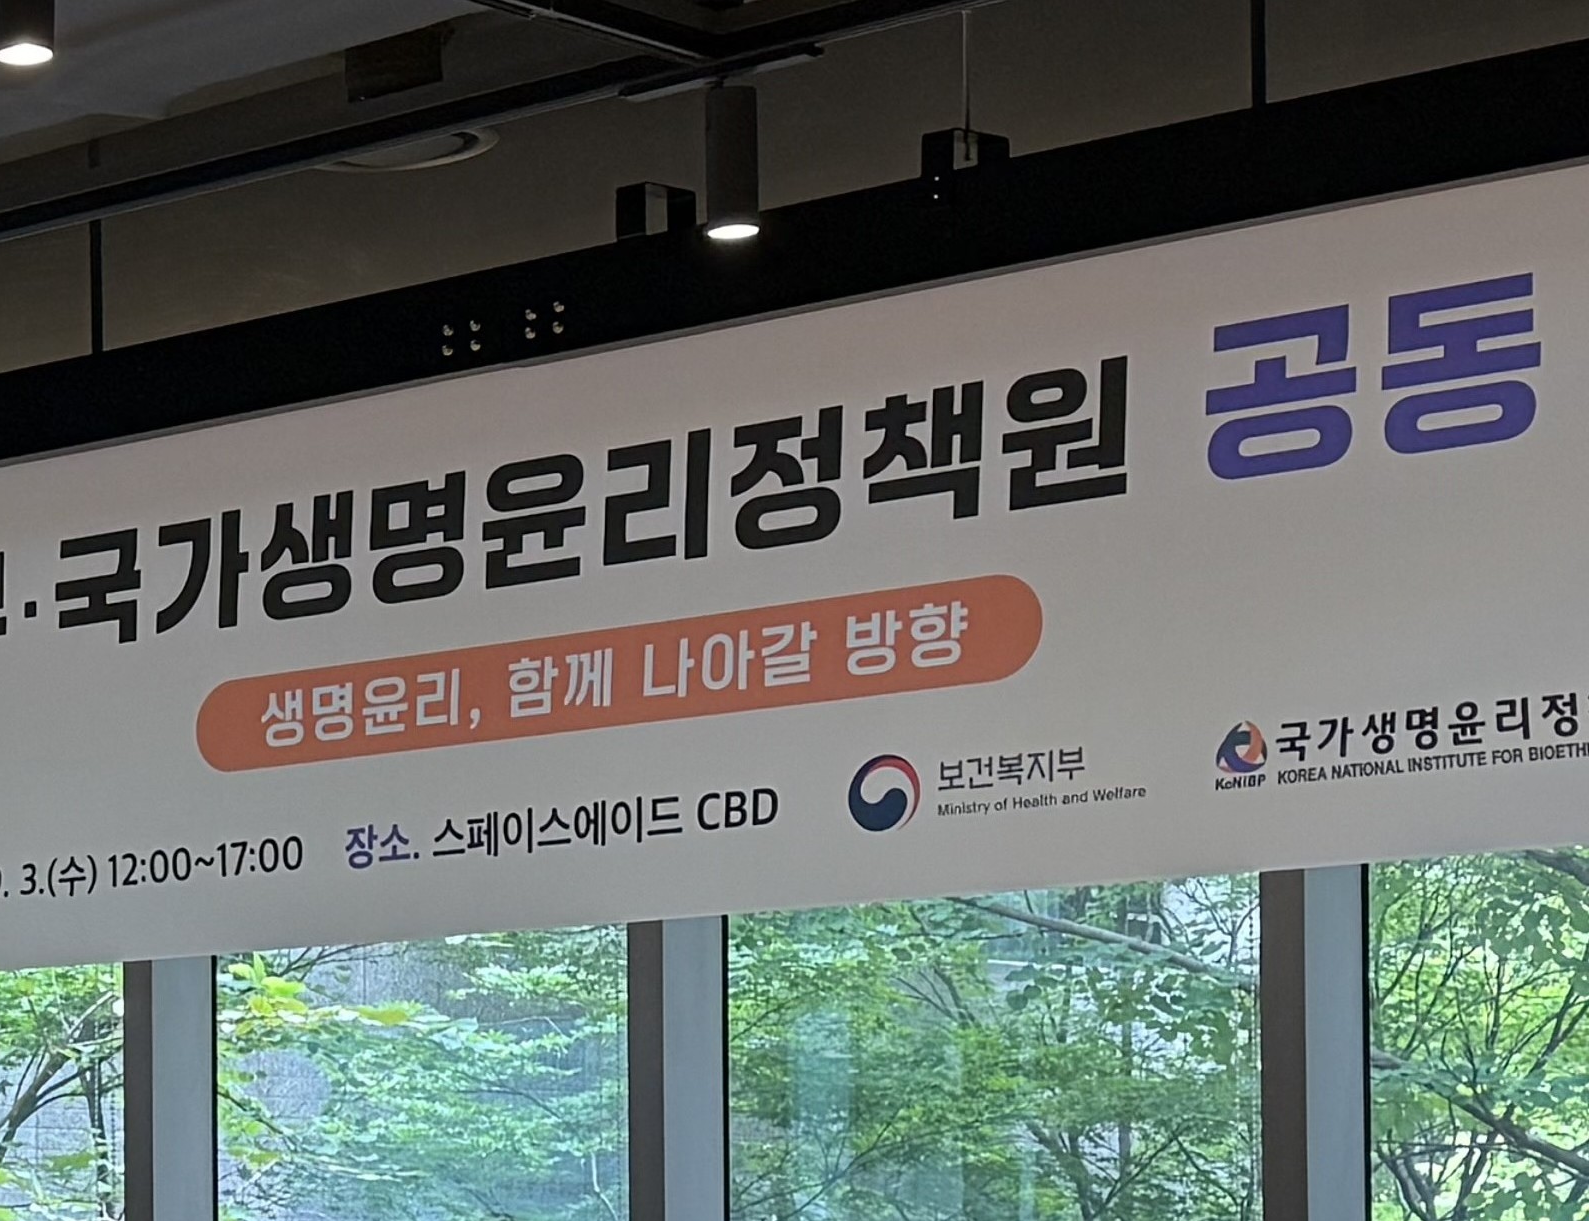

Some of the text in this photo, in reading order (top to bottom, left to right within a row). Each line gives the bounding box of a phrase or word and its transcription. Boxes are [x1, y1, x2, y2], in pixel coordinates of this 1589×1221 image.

[1205, 271, 1542, 481] 공동
[260, 600, 970, 748] 생명윤리, 함께 나아갈 방향
[1275, 691, 1589, 762] 국가생명윤리정
[937, 746, 1086, 792] 보건복지부
[937, 785, 1148, 817] Ministry of Health and Welfare
[1277, 766, 1328, 785] KOREA
[1331, 758, 1405, 781] NATIONAL
[1407, 749, 1487, 774] INSTITUTE
[1492, 747, 1524, 766] FOR
[107, 834, 304, 889] 12:00~17:00
[344, 822, 421, 870] 장소.
[431, 795, 684, 858] 스페이스에이드
[697, 787, 780, 832] CBD
